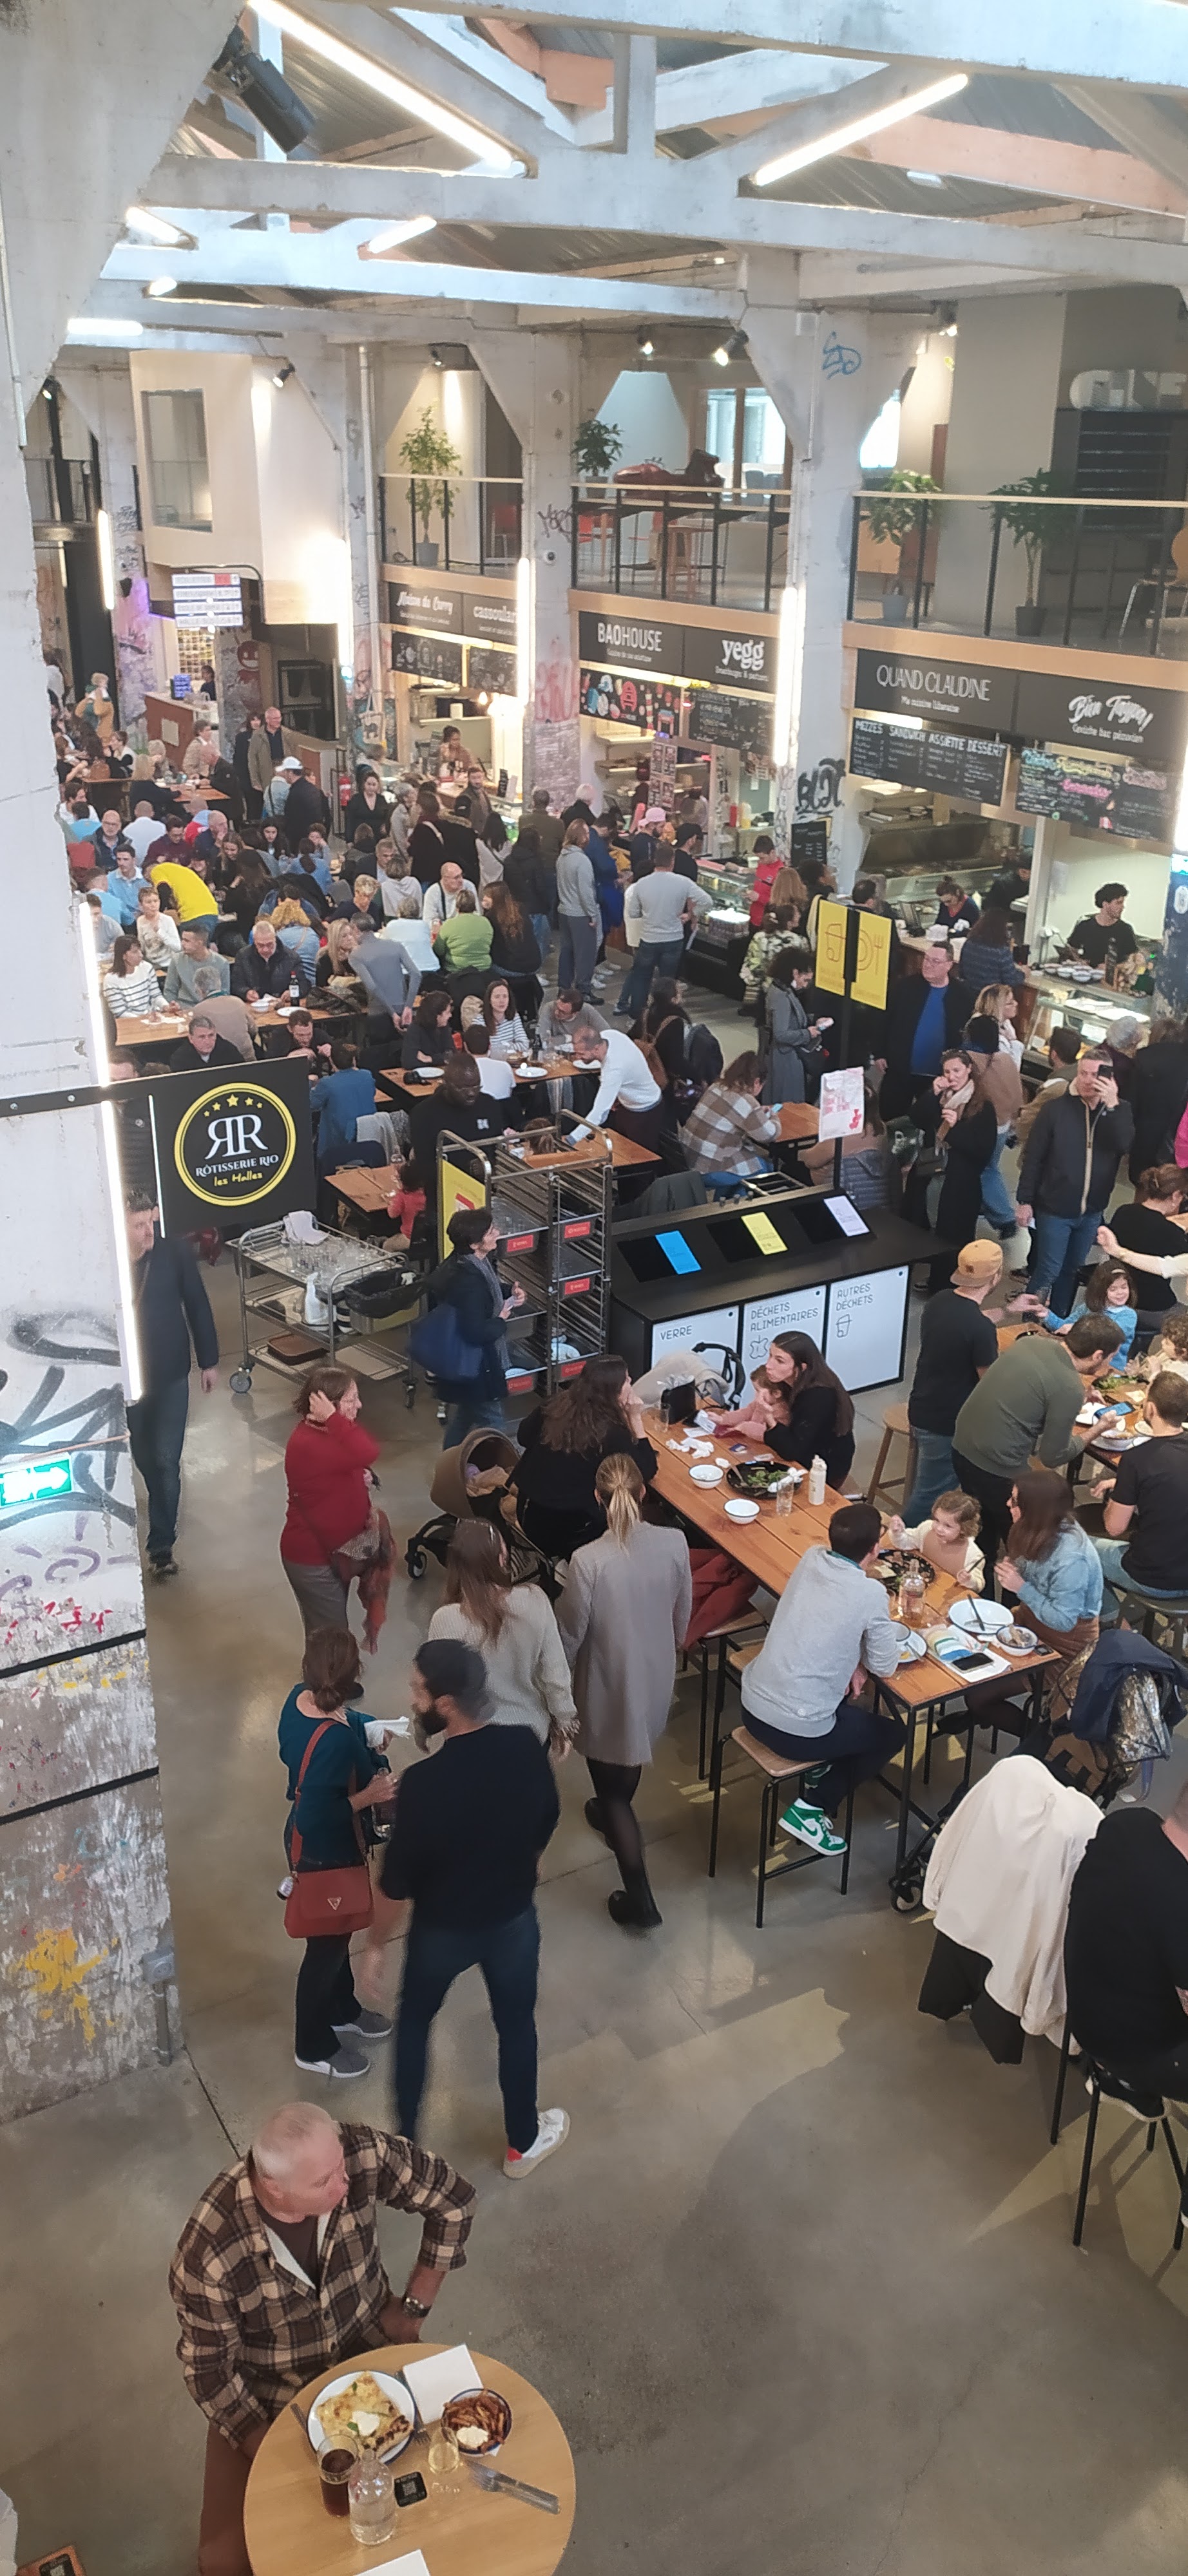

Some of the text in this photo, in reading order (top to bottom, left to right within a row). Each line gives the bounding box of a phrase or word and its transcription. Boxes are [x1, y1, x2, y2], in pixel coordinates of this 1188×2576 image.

[597, 622, 662, 652] BAOHOUSE
[722, 639, 765, 670] yegg
[876, 665, 992, 701] QUAND CLAUDINE
[1068, 694, 1102, 723] Bien
[855, 720, 1006, 757] MEZZES SANDWICH ASSIETTE DESSERT
[196, 1154, 279, 1177] RÔTISSERIE RIO
[214, 1170, 263, 1186] les Halles
[837, 1282, 871, 1298] AUTRES
[751, 1301, 790, 1320] DÉCHETS
[836, 1294, 874, 1312] DÉCHETS
[750, 1307, 819, 1332] ALIMENTAIRES
[660, 1325, 693, 1341] VERRE
